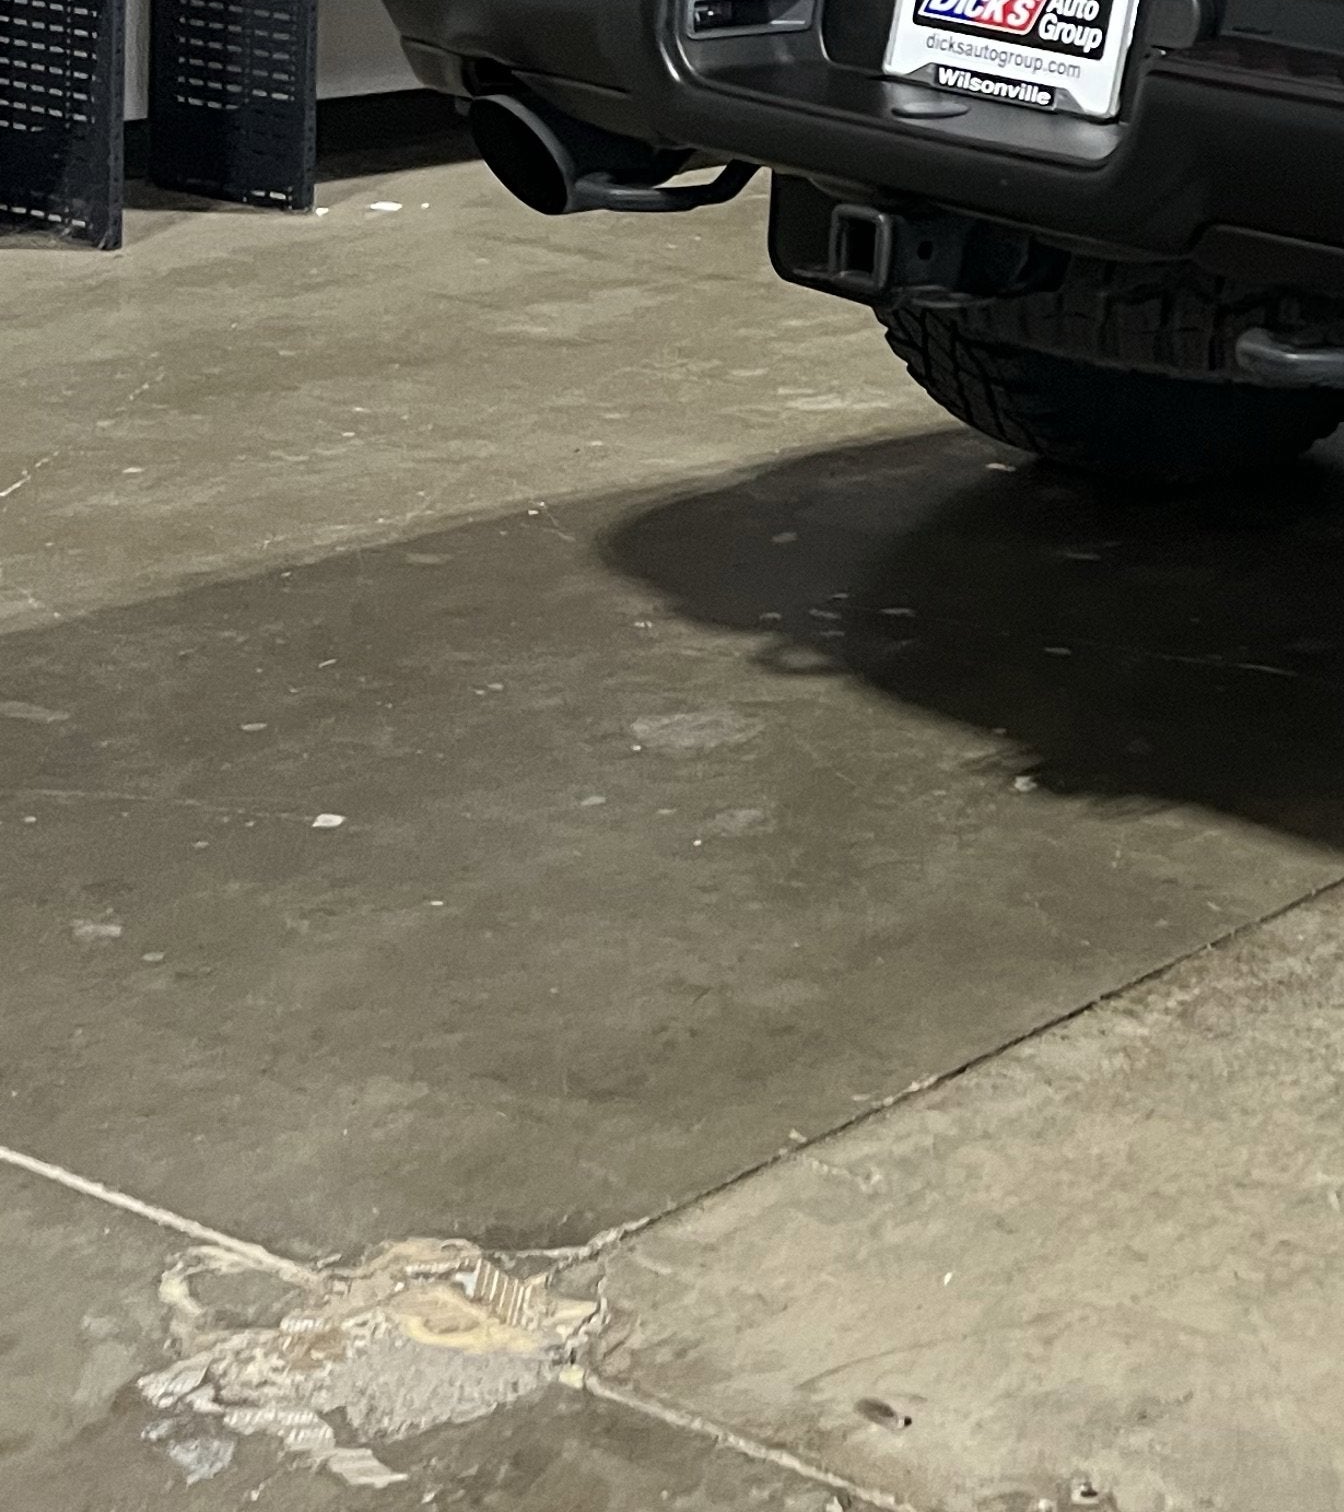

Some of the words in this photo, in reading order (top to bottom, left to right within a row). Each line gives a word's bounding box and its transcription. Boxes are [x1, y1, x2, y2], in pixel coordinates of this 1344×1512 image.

[1038, 13, 1103, 53] Group
[926, 33, 1081, 78] dicksautogroup.com
[938, 67, 1051, 105] Wilsonville
